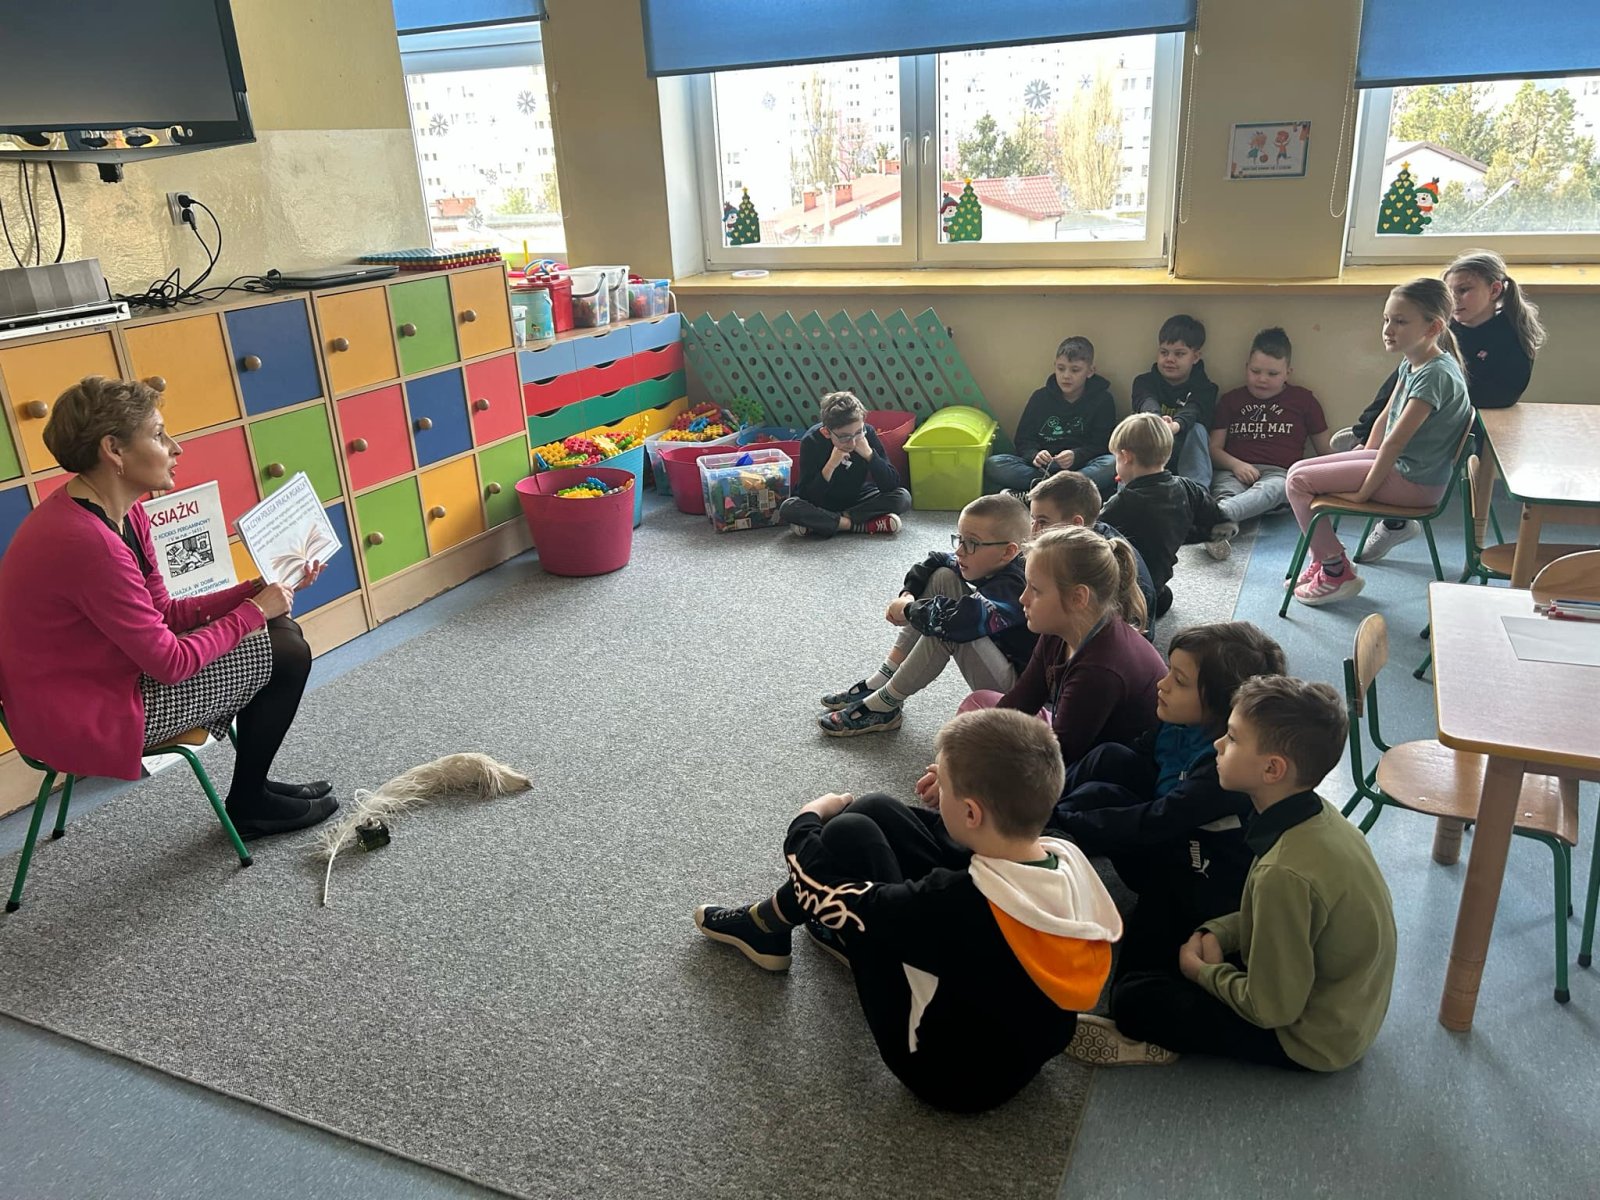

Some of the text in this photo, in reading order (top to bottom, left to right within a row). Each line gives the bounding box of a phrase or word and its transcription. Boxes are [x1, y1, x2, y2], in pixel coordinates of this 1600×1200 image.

[1269, 403, 1284, 415] NA
[1229, 422, 1293, 434] SZACH MAT
[150, 500, 199, 528] KSIĄŻKI
